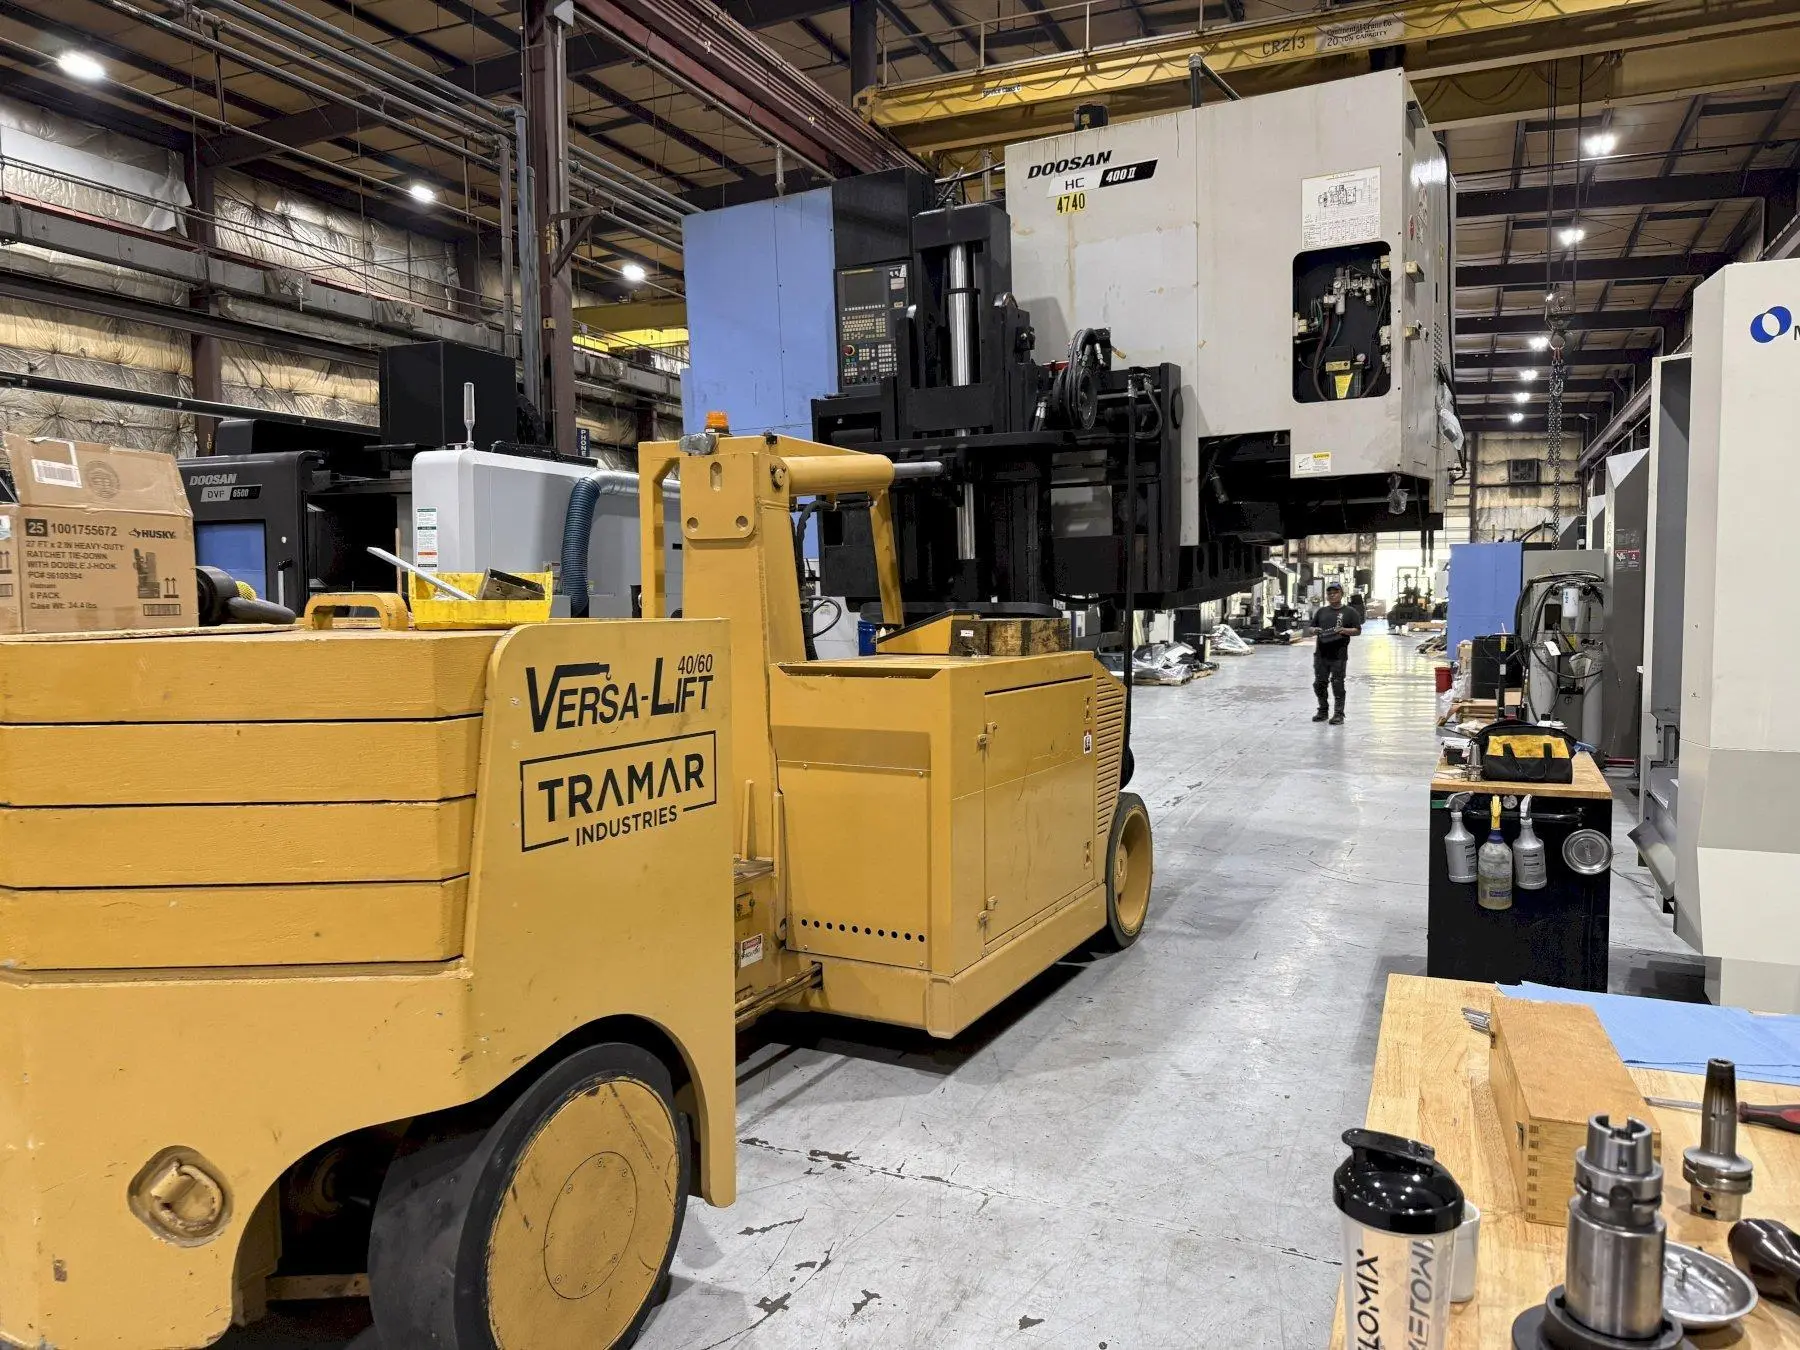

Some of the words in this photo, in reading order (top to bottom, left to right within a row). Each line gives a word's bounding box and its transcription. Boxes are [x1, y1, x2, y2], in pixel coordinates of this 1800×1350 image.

[1262, 36, 1306, 56] CR213
[1327, 36, 1338, 46] 20
[1028, 150, 1112, 179] DOOSAN
[1065, 178, 1085, 190] HC
[1057, 192, 1086, 213] 4740
[190, 474, 237, 486] DOOSAN
[28, 522, 44, 534] 25
[51, 524, 118, 536] 1001755672
[142, 530, 175, 538] HUSKY
[27, 550, 66, 558] RATCHET
[677, 653, 714, 675] 40/60
[526, 657, 714, 732] VERSA-LIFT
[538, 753, 704, 823] TRAMAR
[576, 804, 678, 846] INDUSTRIES
